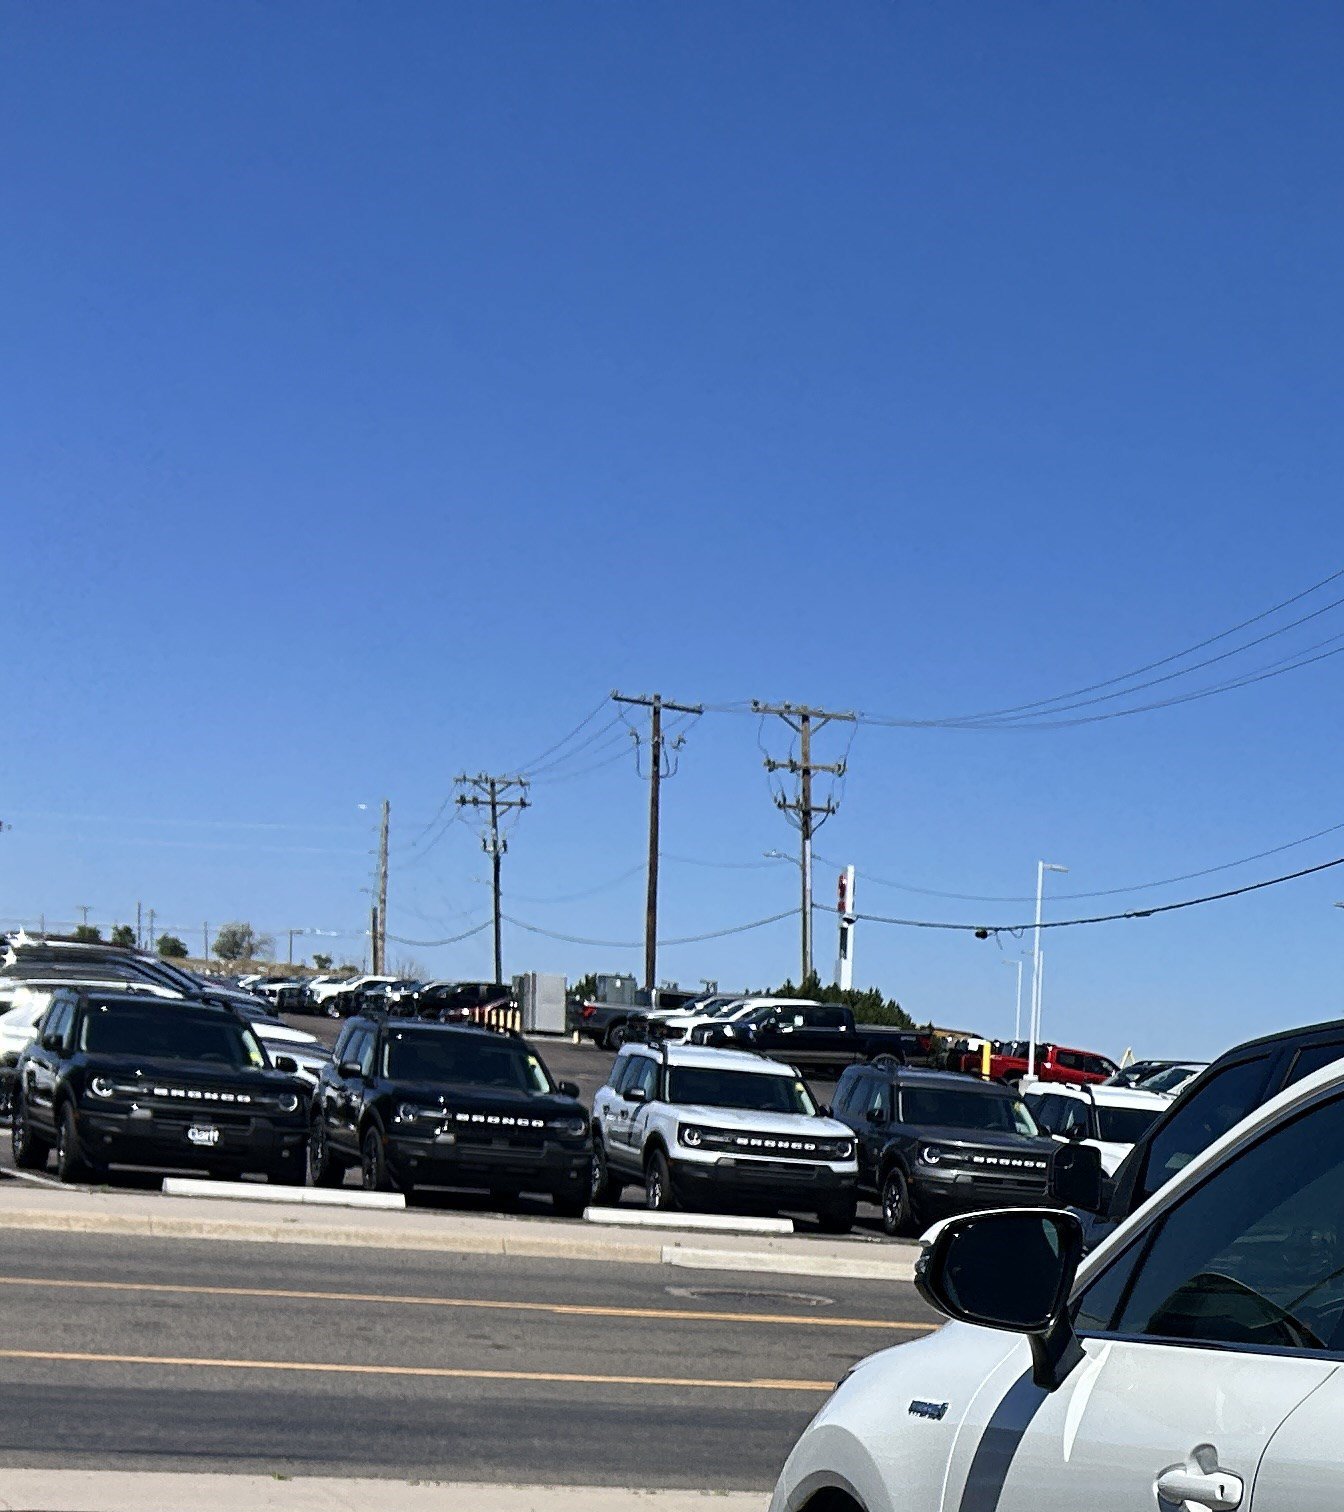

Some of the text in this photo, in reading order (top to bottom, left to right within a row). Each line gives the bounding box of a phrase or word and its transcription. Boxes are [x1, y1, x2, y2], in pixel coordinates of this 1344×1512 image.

[153, 1087, 251, 1103] BRONCO
[456, 1113, 544, 1128] BRONCO
[736, 1137, 816, 1151] BRONCO
[973, 1155, 1047, 1169] BRONCO
